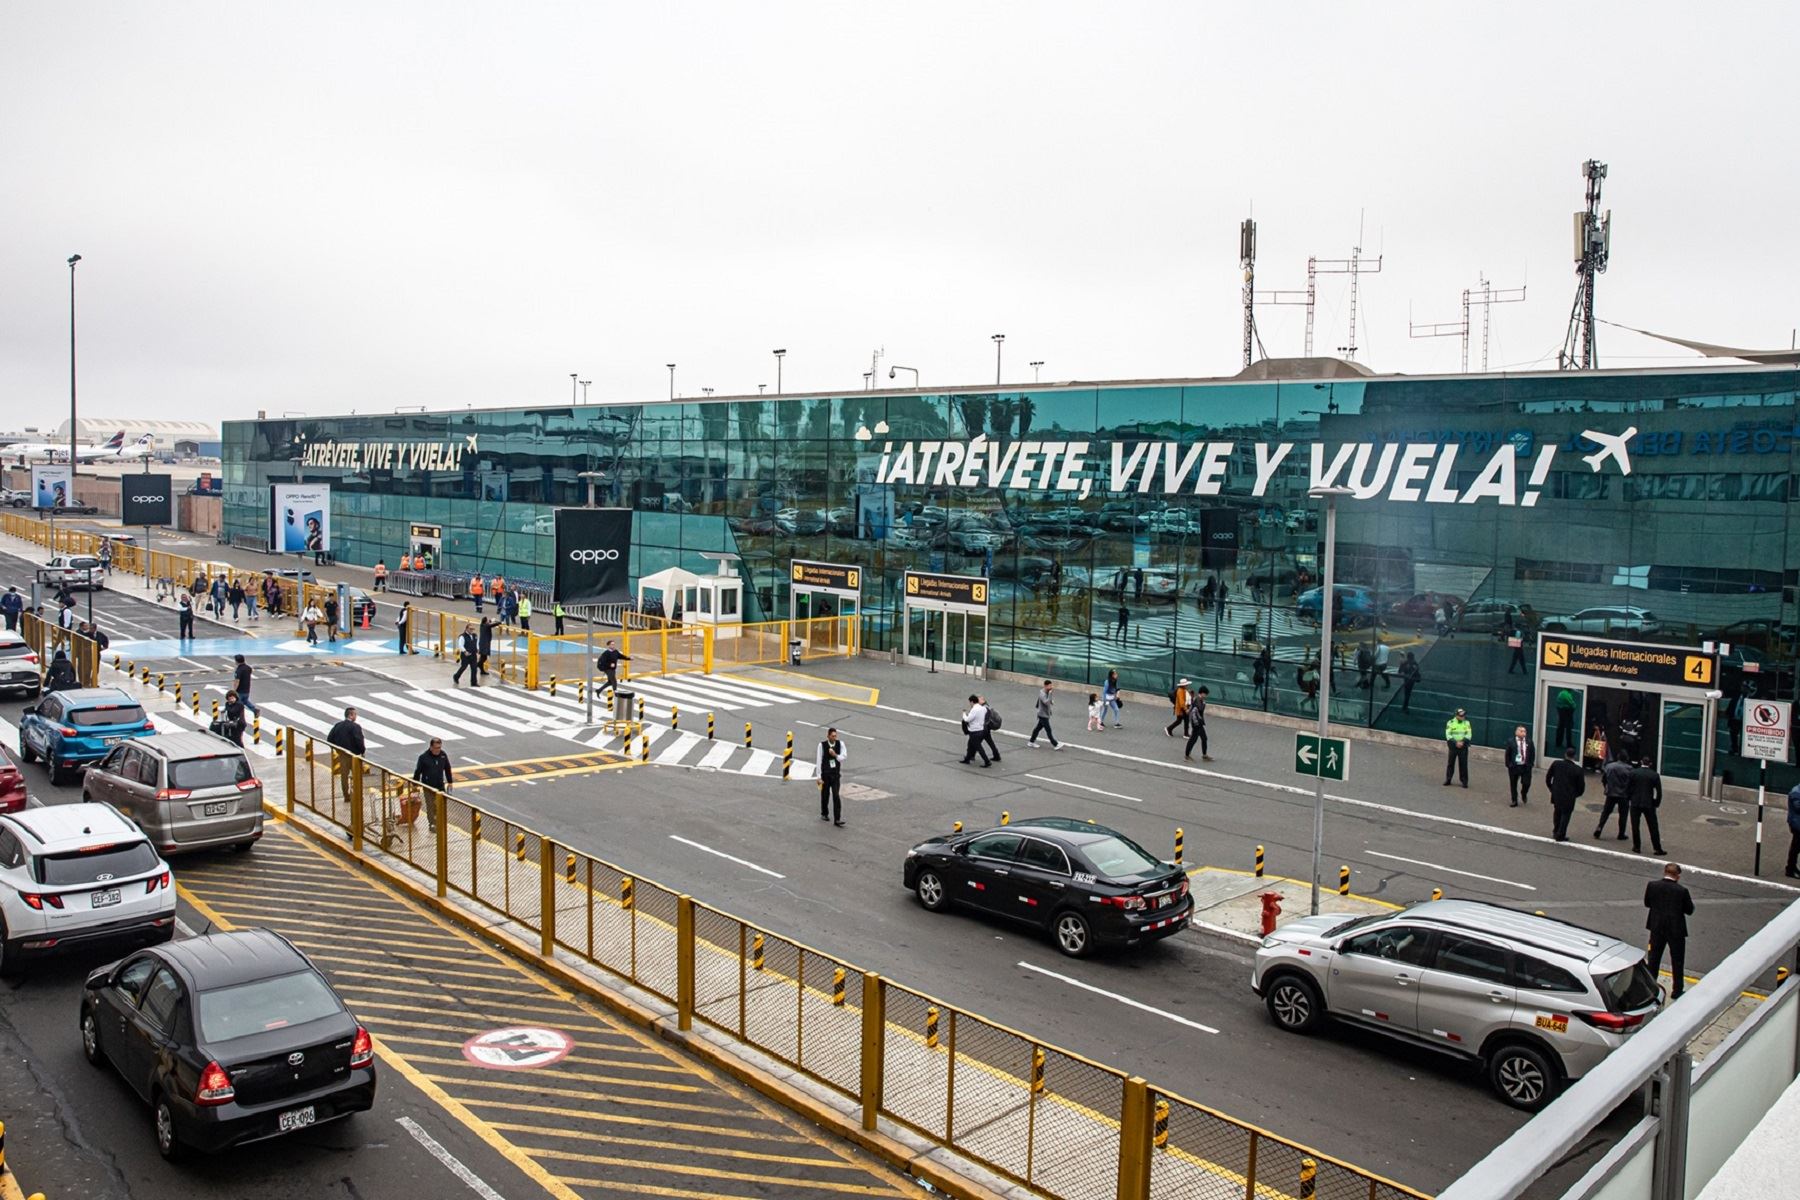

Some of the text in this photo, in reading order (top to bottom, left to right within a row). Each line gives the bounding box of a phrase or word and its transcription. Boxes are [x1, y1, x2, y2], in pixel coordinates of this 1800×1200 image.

[302, 439, 463, 473] ¡ATRÉVETE, VIVE Y VUELA!
[875, 432, 1093, 500] ¡ATRÉVETE,
[1110, 442, 1234, 495] VIVE
[1252, 442, 1295, 497] Y
[1309, 443, 1558, 507] VUELA!
[132, 495, 164, 504] oppo
[570, 549, 619, 564] oppo
[850, 572, 855, 585] 2
[975, 586, 982, 598] 3
[1571, 644, 1677, 666] Llegadas Internacionales
[1569, 659, 1638, 675] International Arrivals
[1691, 660, 1703, 679] 4
[1747, 726, 1784, 737] PROHIBIDO
[282, 1111, 314, 1129] CER-096
